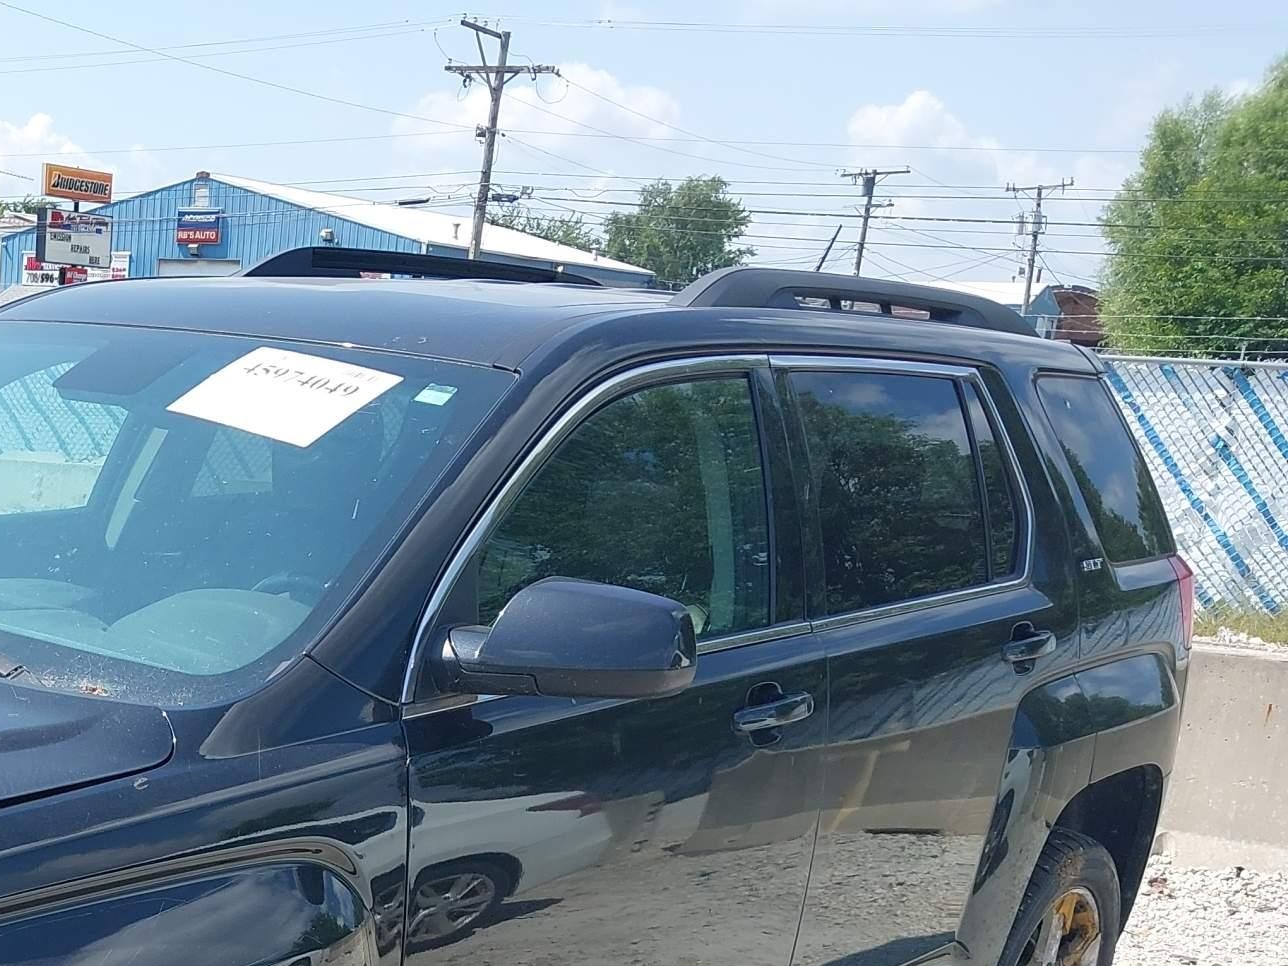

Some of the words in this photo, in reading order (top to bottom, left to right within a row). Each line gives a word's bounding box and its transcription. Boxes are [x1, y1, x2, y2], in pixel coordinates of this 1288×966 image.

[51, 173, 109, 196] BRIDGESTONE
[195, 231, 216, 240] AUTO
[71, 244, 91, 255] REPAIRS
[88, 256, 101, 265] HERE
[26, 272, 59, 284] 708/596-
[243, 363, 360, 398] 45974049
